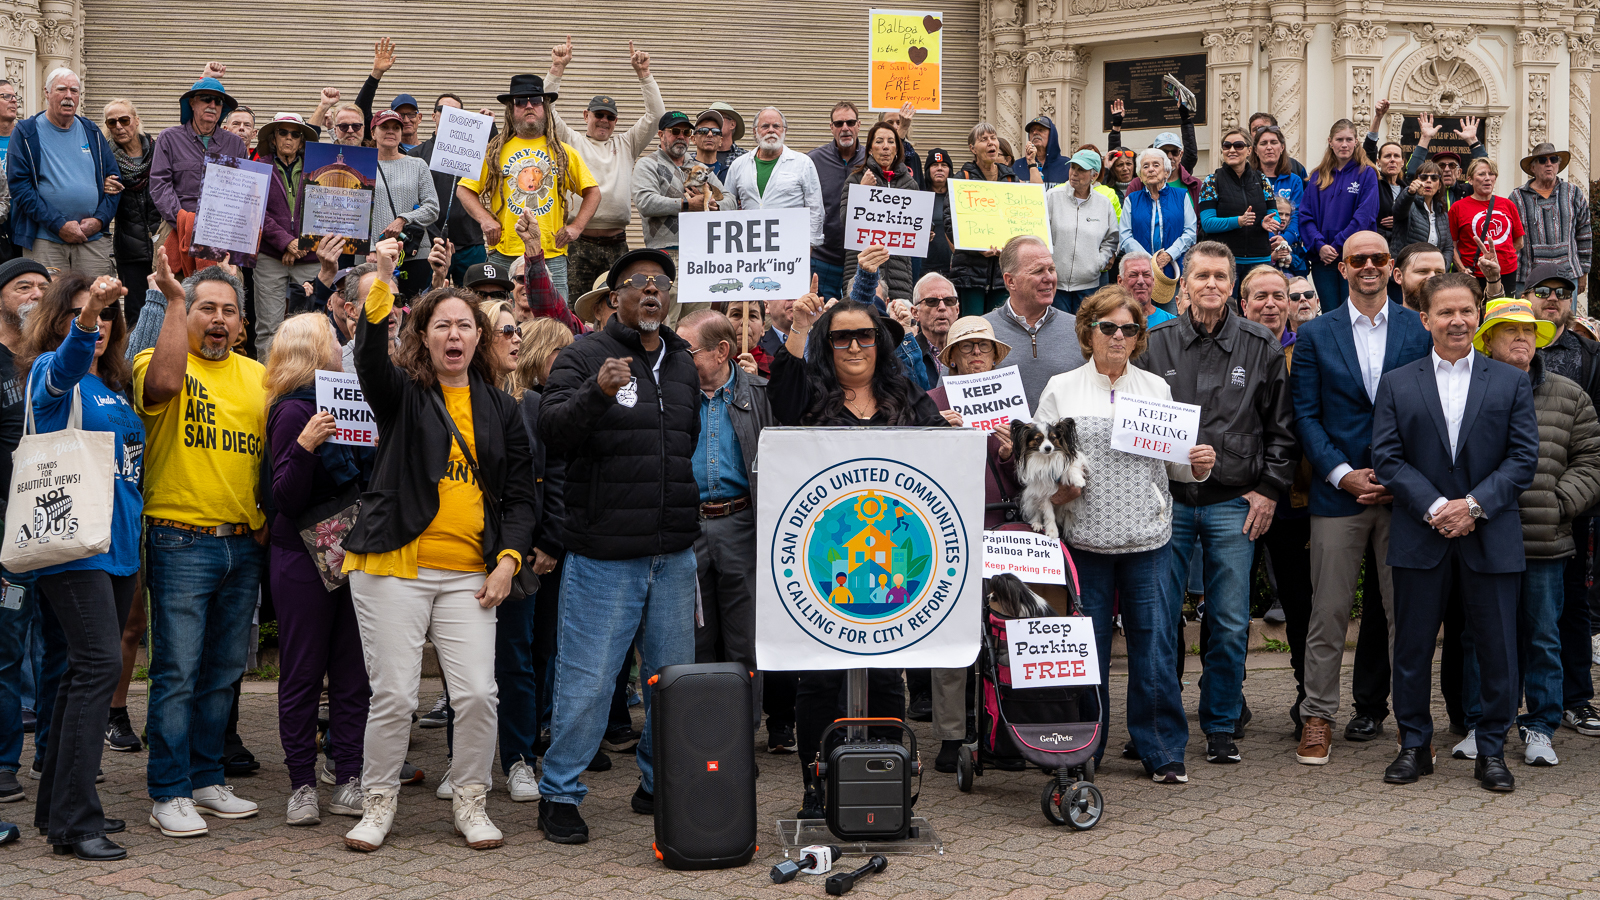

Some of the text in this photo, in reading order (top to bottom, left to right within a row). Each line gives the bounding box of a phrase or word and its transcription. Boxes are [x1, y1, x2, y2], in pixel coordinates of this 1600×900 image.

[878, 18, 918, 34] Balboa
[903, 32, 924, 45] Park
[885, 44, 898, 53] the
[885, 80, 920, 92] FREE
[885, 92, 898, 100] for
[449, 114, 483, 129] DON'T
[450, 130, 474, 143] KILL
[437, 142, 481, 160] BALBOA
[441, 158, 471, 172] PARK
[869, 189, 912, 209] Keep
[963, 190, 1043, 207] Free Balboa
[854, 207, 924, 231] Parking
[966, 221, 995, 235] Park
[707, 219, 780, 254] FREE
[857, 228, 916, 248] FREE
[484, 265, 496, 278] SD
[687, 261, 732, 275] Balboa
[185, 374, 208, 400] WE
[962, 383, 1002, 398] KEEP
[953, 395, 1023, 416] PARKING
[1121, 396, 1148, 405] PAPILLONS
[184, 399, 215, 425] ARE
[1138, 408, 1177, 423] KEEP
[971, 416, 1010, 431] FREE
[1122, 418, 1188, 440] PARKING
[122, 432, 140, 443] NOT
[184, 424, 262, 458] SAN DIEGO
[336, 428, 371, 442] FREE
[1133, 436, 1172, 454] FREE
[16, 439, 85, 475] Linda Vista
[37, 461, 57, 471] STANDS
[17, 474, 81, 494] BEAUTIFUL VIEWS!
[36, 487, 65, 506] NOT
[781, 468, 960, 565] SAN DIEGO UNITED COMMUNITIES
[983, 535, 1058, 549] Papillons Love
[987, 546, 1050, 558] Balboa Park
[985, 561, 1061, 575] Keep Parking Free
[786, 579, 953, 644] CALLING FOR CITY REFORM
[1028, 620, 1072, 637] Keep
[1015, 639, 1089, 658] Parking
[1023, 660, 1086, 680] FREE
[1040, 732, 1073, 745] Gen7Pets
